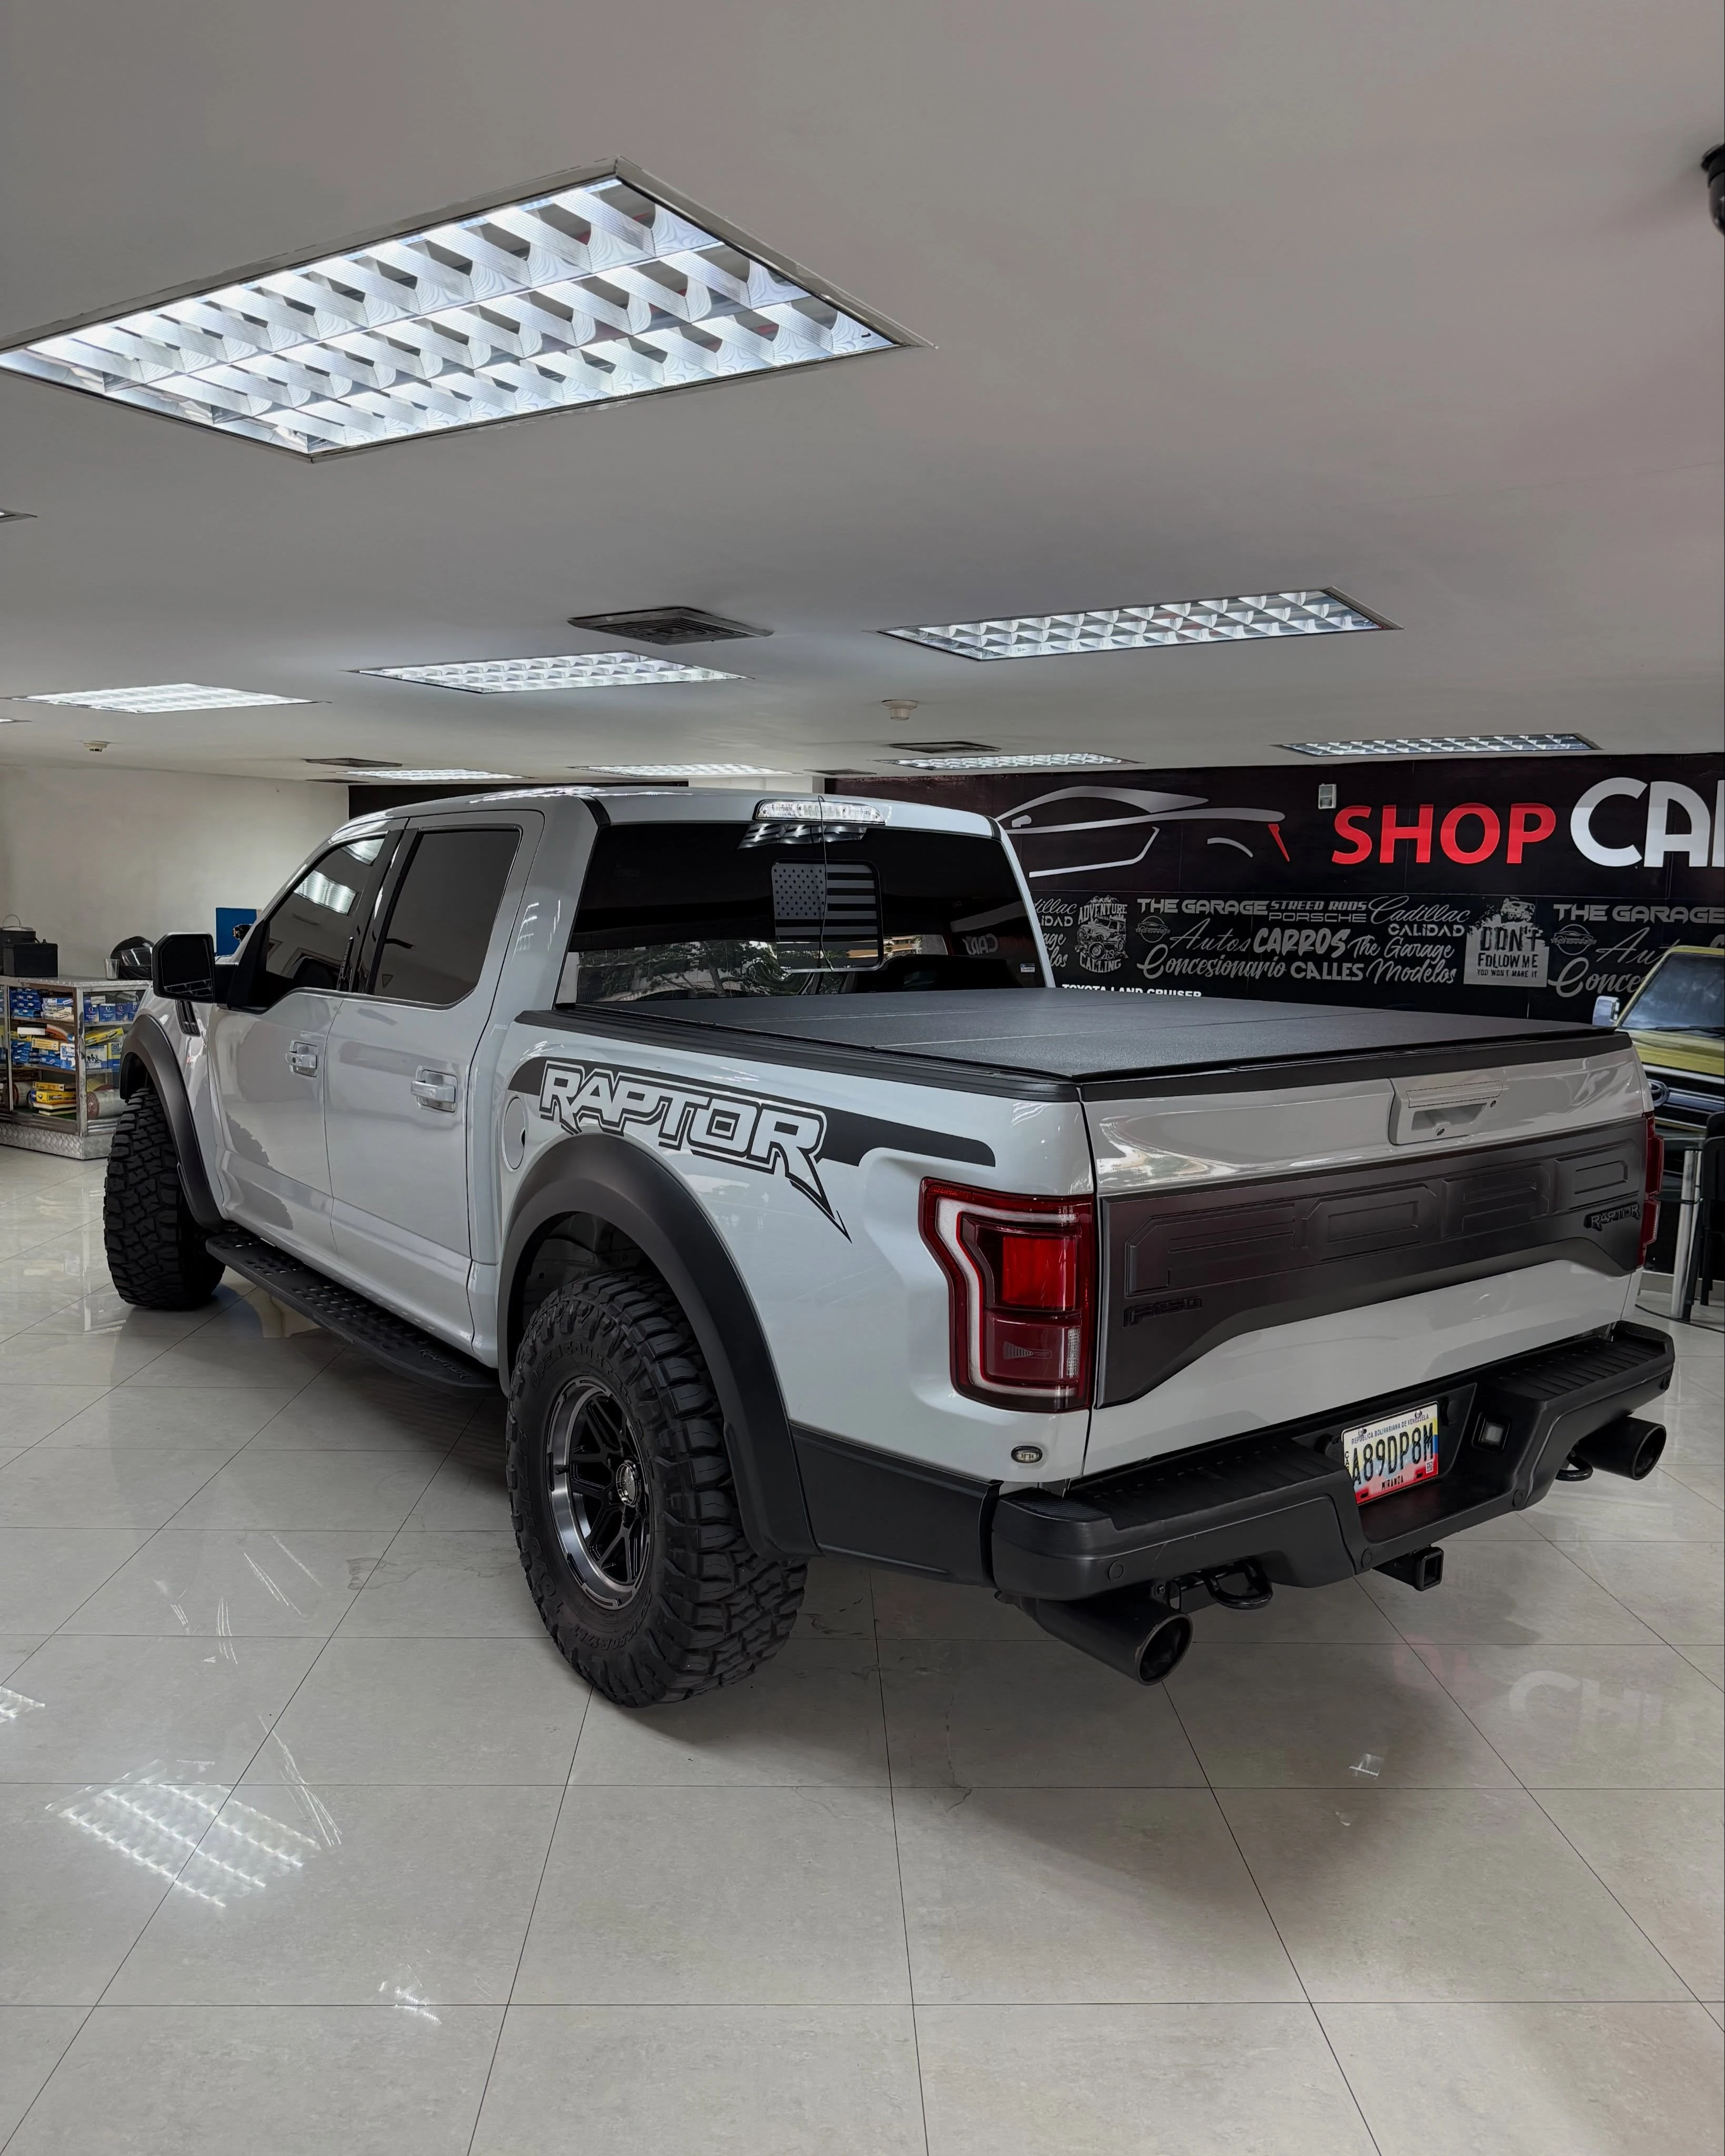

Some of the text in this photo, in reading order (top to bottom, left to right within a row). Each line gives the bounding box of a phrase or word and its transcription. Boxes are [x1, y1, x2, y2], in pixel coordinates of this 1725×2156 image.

[1332, 777, 1724, 867] SHOP CA
[1078, 903, 1128, 925] ADVENTURE
[1137, 897, 1270, 915] THE GARAGE
[1269, 912, 1367, 922] PORSCHE
[1270, 901, 1368, 911] STREED RODS
[1368, 895, 1471, 924] Cadillac
[1553, 903, 1724, 924] THE GARAGE
[1039, 915, 1073, 927] IDAD
[1388, 923, 1465, 937] CALIDAD
[1170, 917, 1455, 964] Autos CARROS The Garage
[1080, 952, 1122, 973] CALLING
[1137, 944, 1457, 984] Concesionario CALLES Modelos
[1478, 952, 1539, 969] FOLLOW ME
[539, 1060, 852, 1244] RAPTOR
[1125, 1139, 1641, 1296] FORD
[1590, 1203, 1641, 1232] RAPTOR
[1374, 1423, 1400, 1436] BOLIVARIANA
[1408, 1414, 1429, 1424] VENEZUELA
[1352, 1422, 1433, 1486] A89DP8M
[1382, 1475, 1403, 1490] MIRANDA
